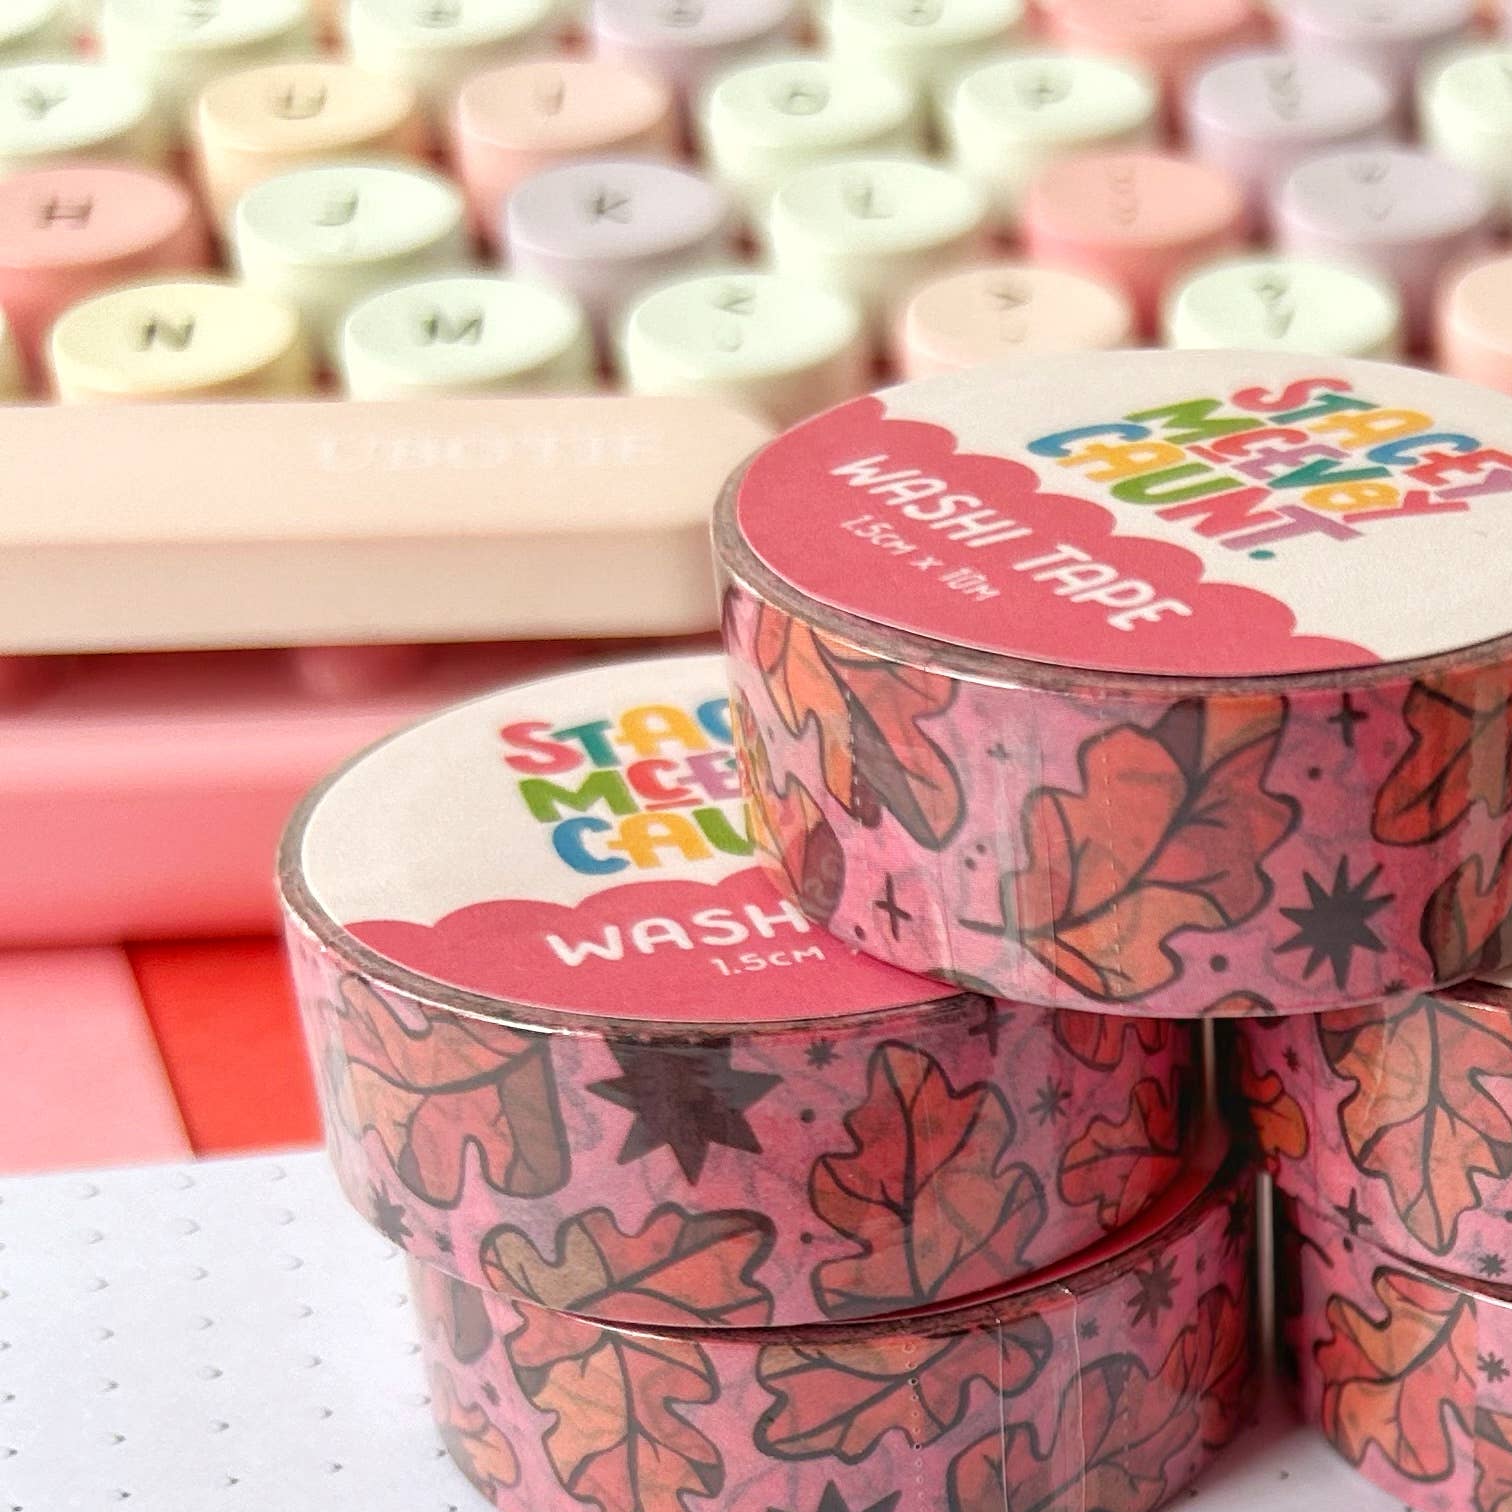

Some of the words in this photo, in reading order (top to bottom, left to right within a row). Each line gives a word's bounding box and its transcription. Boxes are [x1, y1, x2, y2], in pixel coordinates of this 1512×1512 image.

[36, 195, 96, 230] H
[135, 311, 196, 352] N
[418, 306, 485, 348] M
[830, 454, 1033, 547] WASHI
[1011, 543, 1193, 631] TAPE
[501, 699, 733, 775] STAC
[518, 751, 742, 822] MCE
[552, 803, 756, 875] CAU
